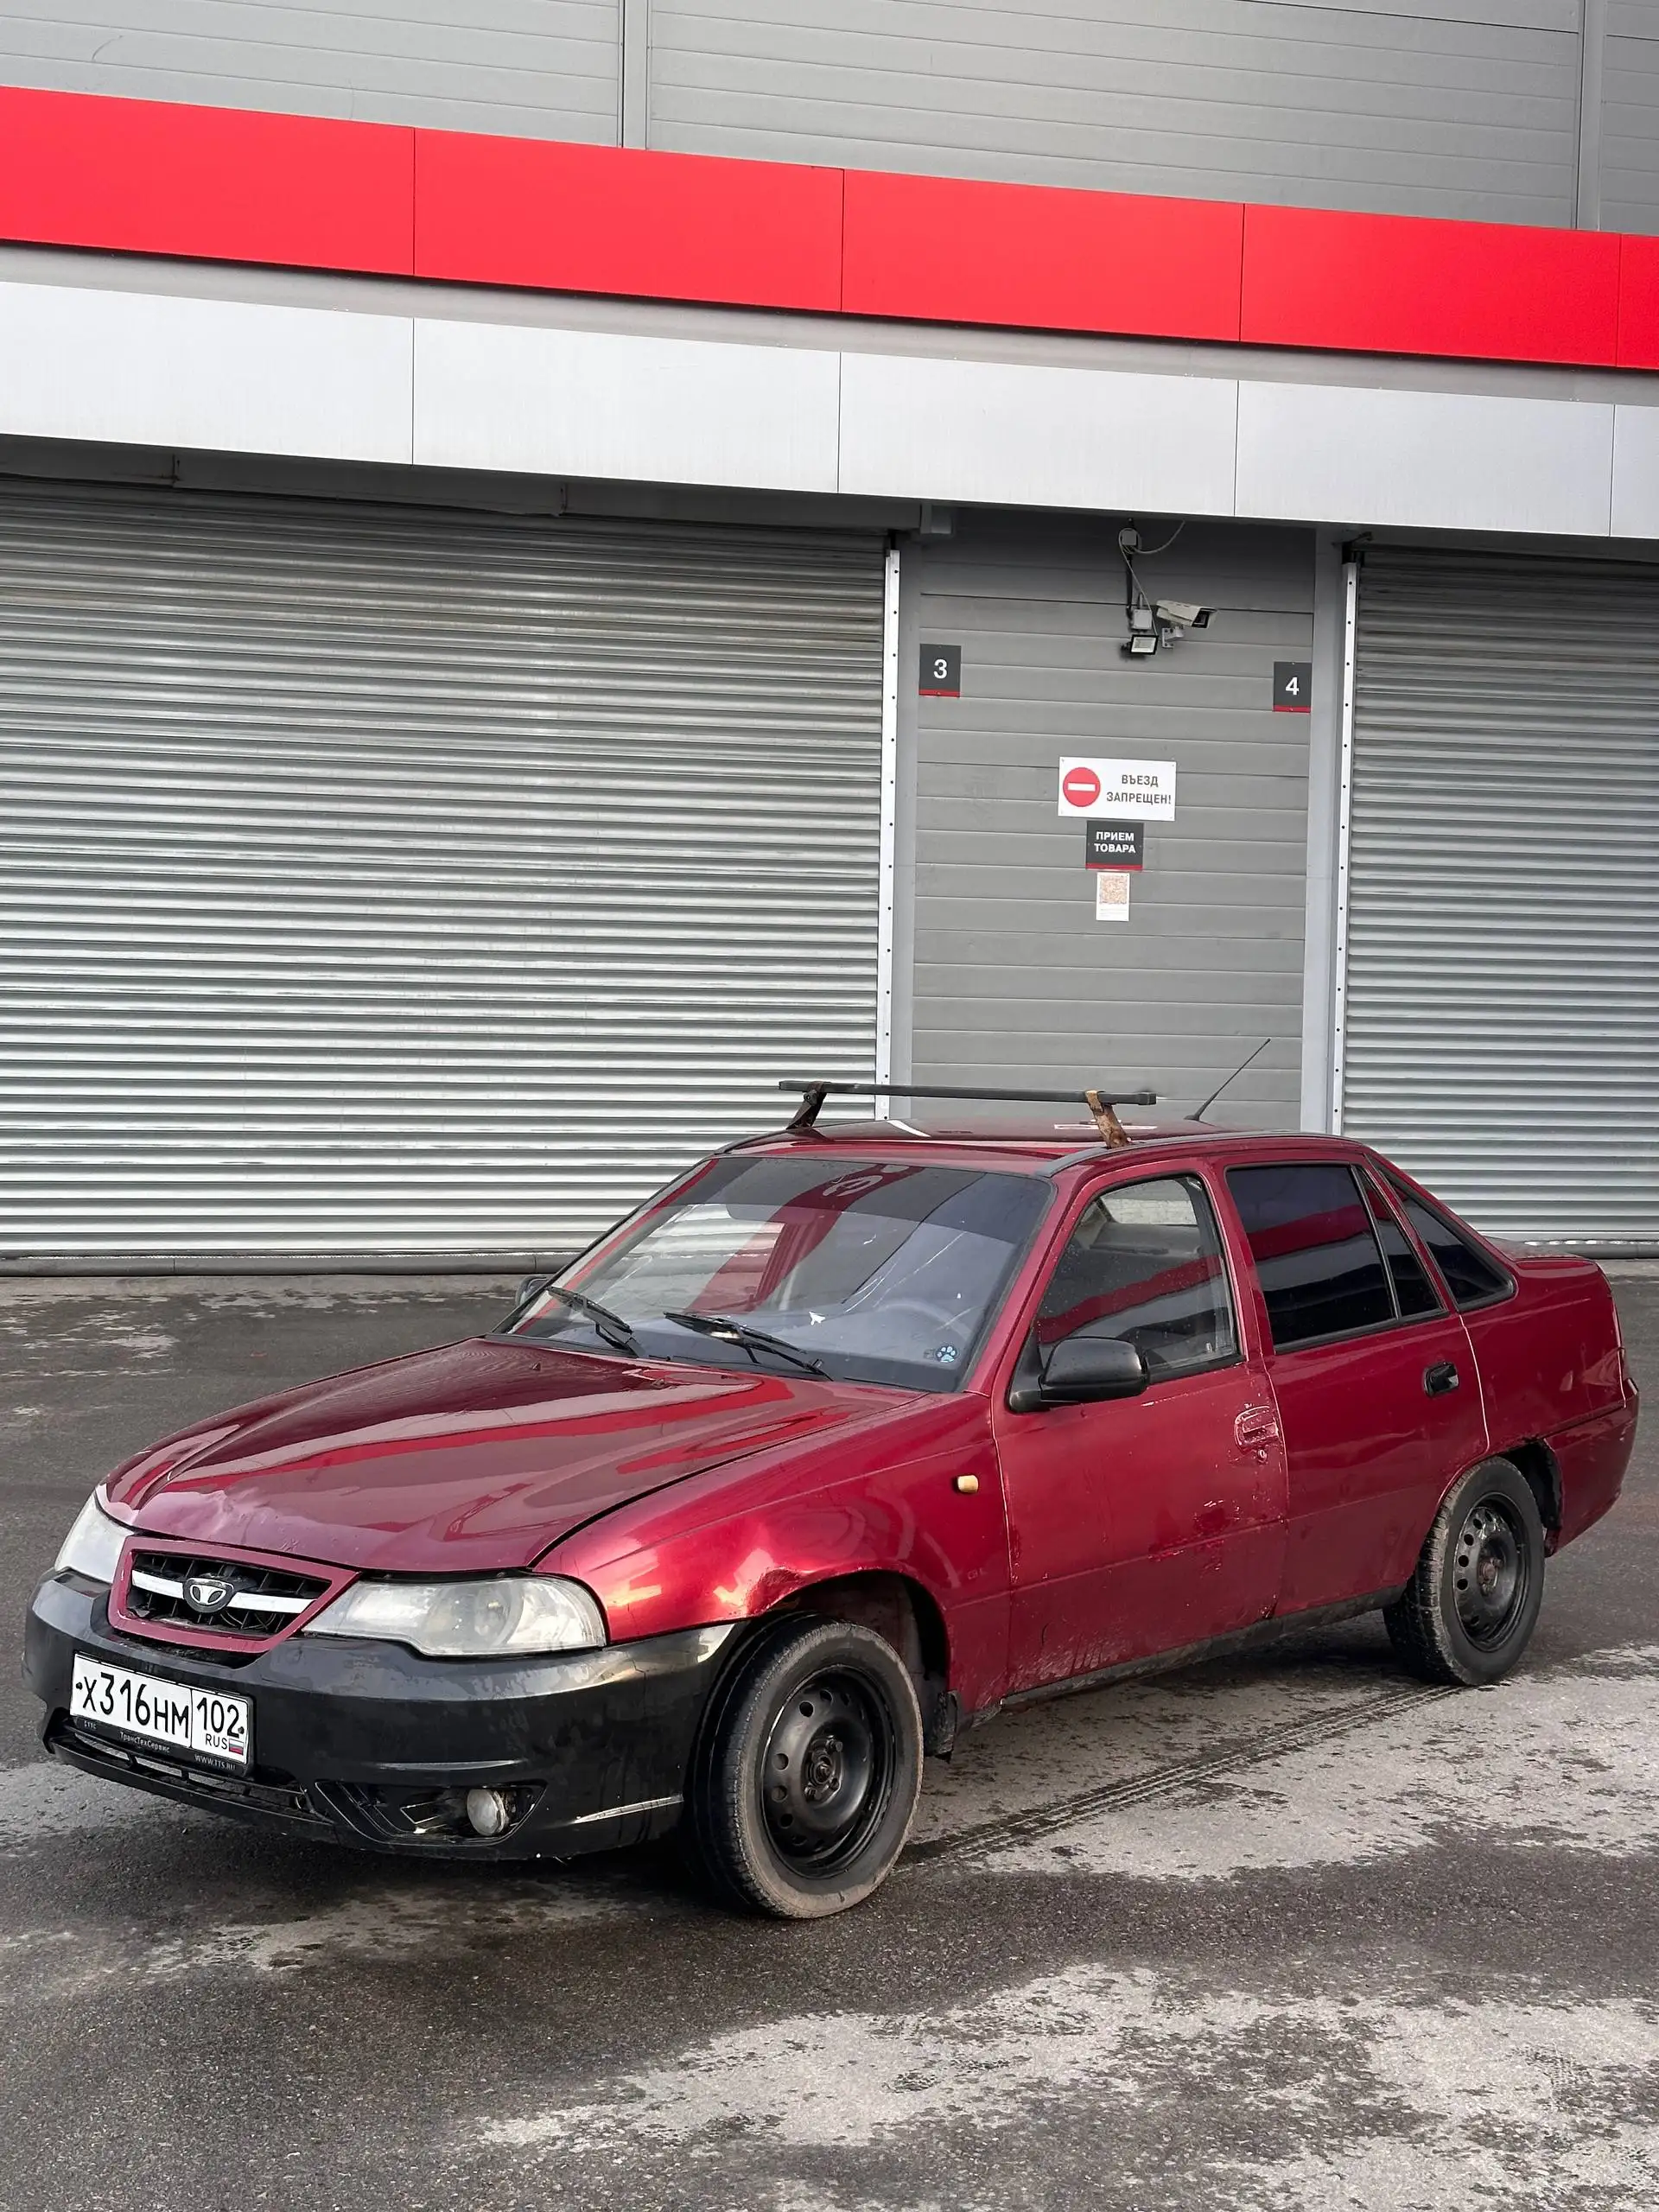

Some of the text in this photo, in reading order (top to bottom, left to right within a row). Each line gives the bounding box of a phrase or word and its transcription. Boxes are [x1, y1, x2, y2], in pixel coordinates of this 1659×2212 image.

[933, 658, 948, 679] 3
[1285, 677, 1300, 696] 4
[1122, 774, 1159, 787] ВЪЕЗД
[1106, 791, 1172, 805] ЗАПРЕЩЕН!
[1096, 831, 1135, 842] ПРИЕМ
[1094, 842, 1136, 854] ТОВАРА
[83, 1671, 239, 1738] Х316НМ 102
[205, 1733, 228, 1750] RUS
